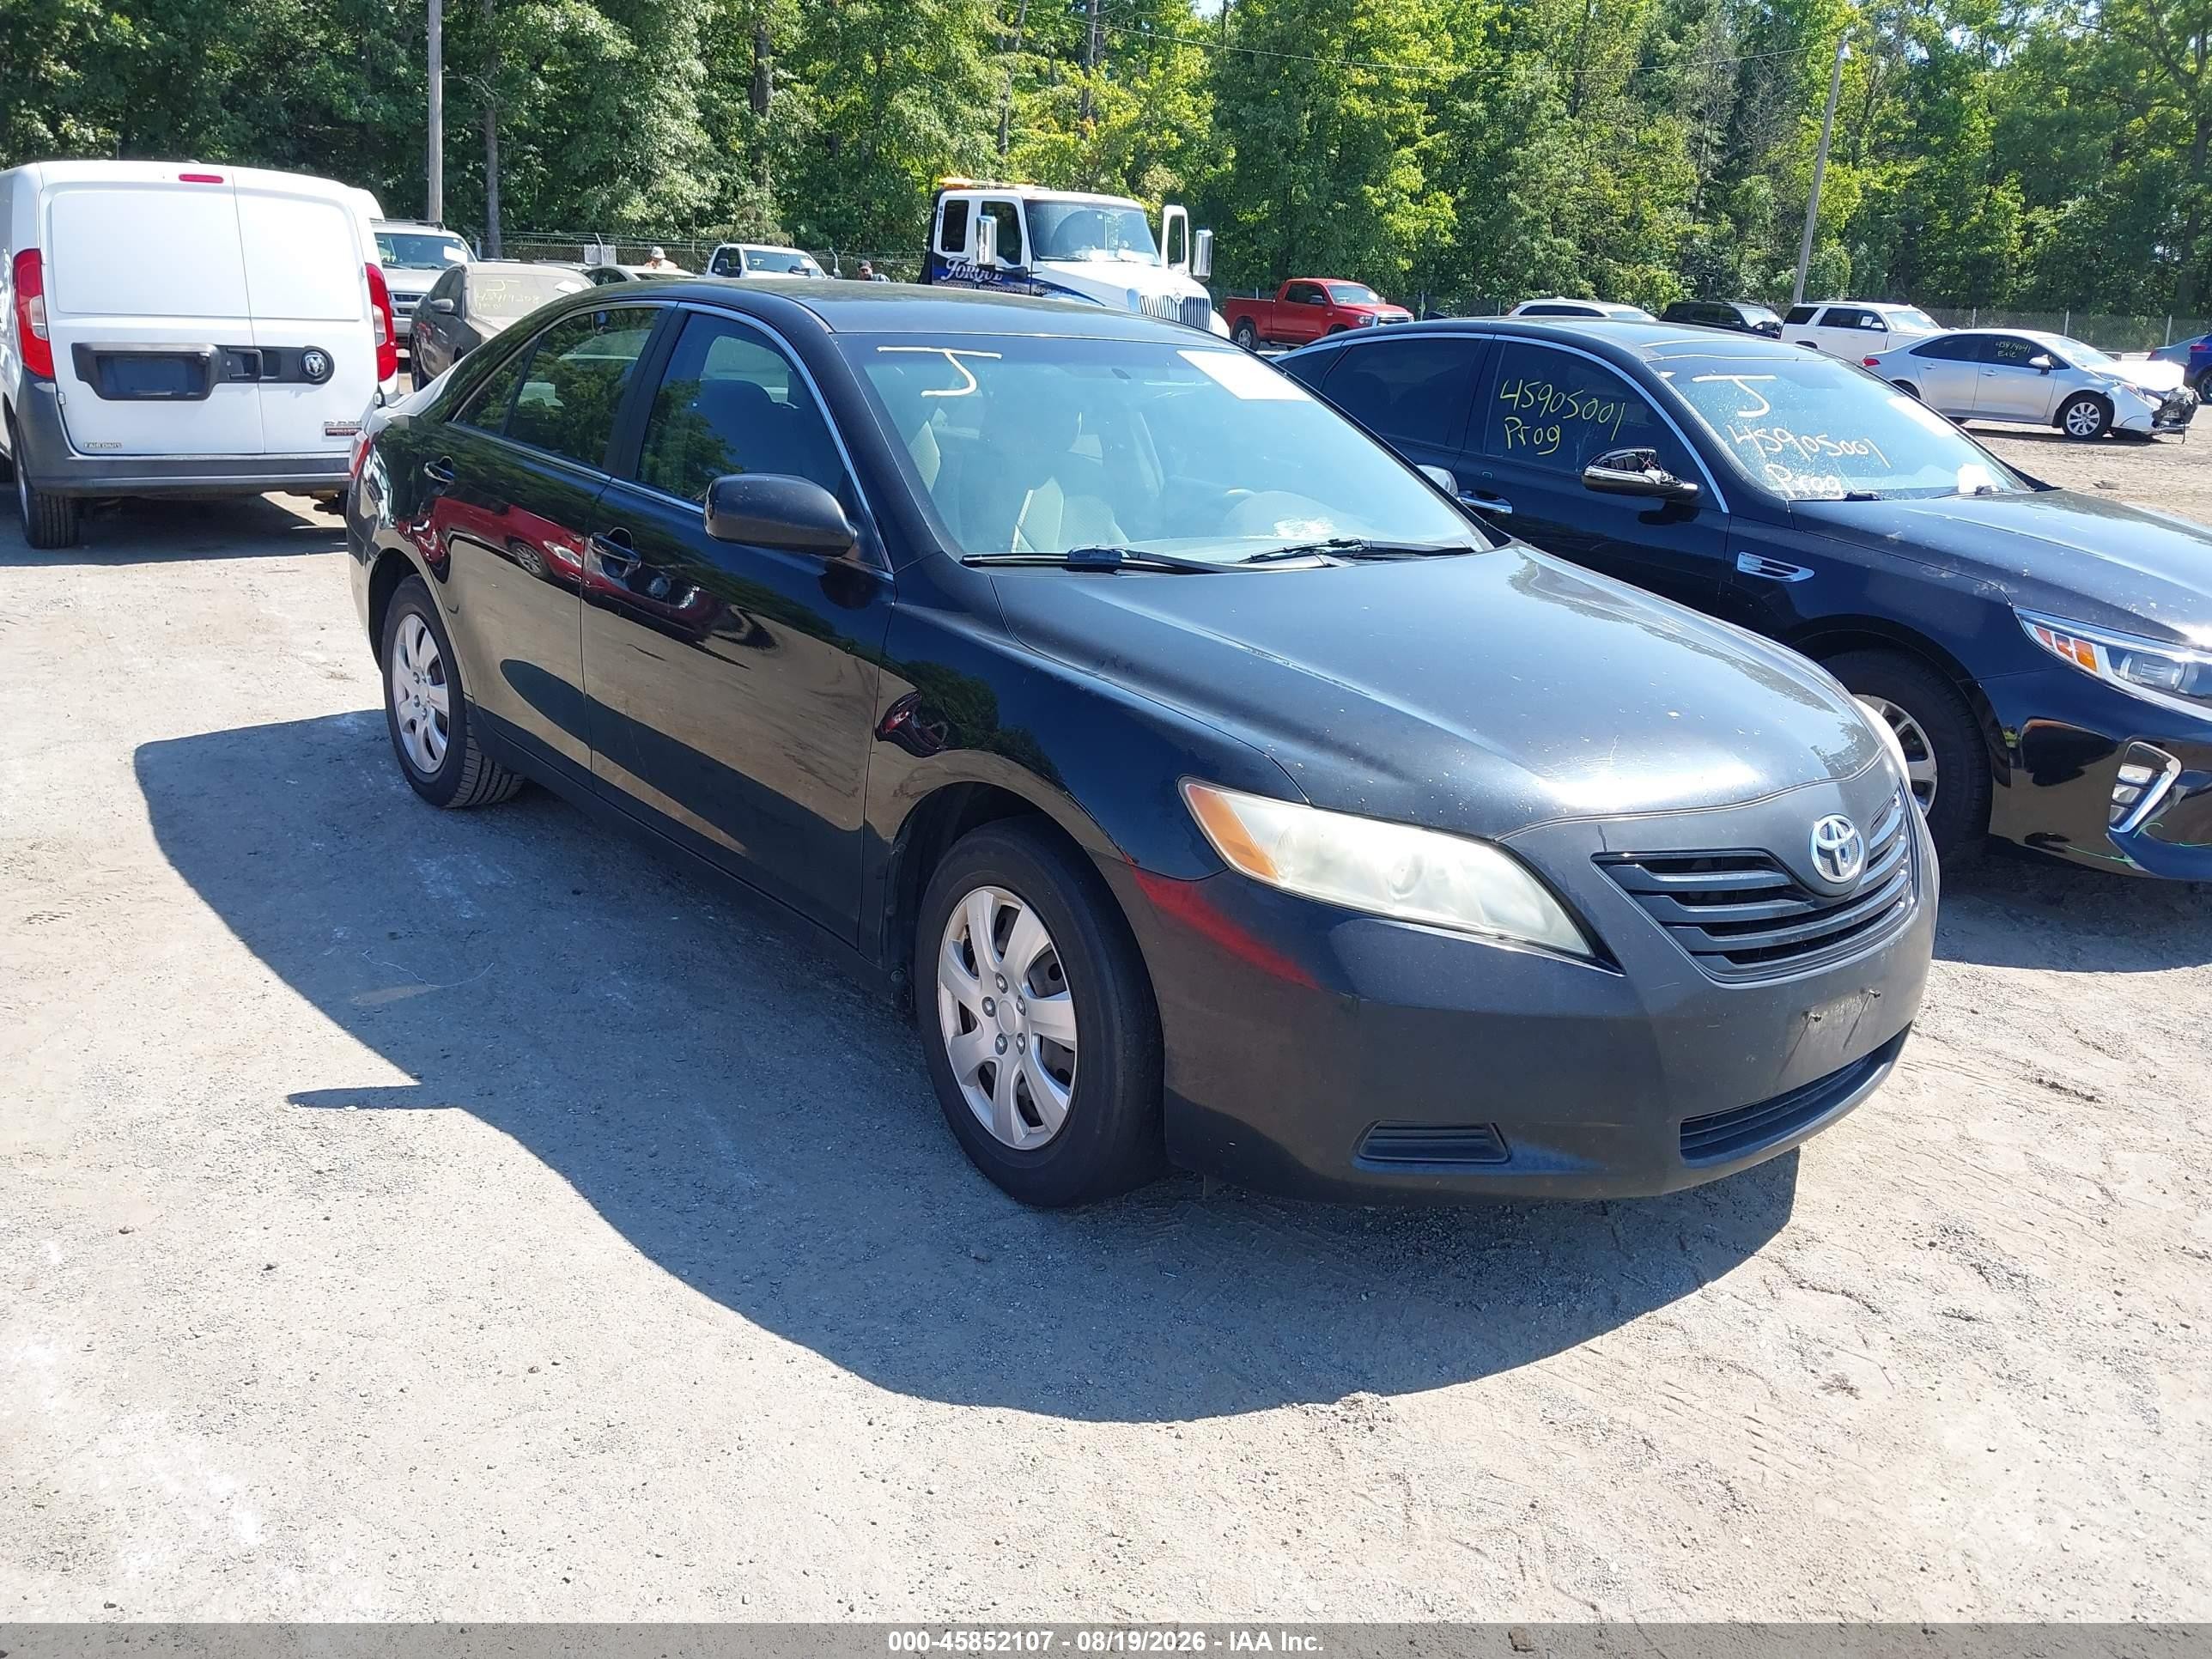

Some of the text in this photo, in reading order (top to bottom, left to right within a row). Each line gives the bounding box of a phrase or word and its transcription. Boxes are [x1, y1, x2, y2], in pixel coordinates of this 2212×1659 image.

[876, 346, 1003, 398] J
[1499, 379, 1626, 442] 45905001
[1692, 374, 1778, 418] J
[1504, 416, 1561, 455] Prog
[1726, 423, 1893, 469] 45905001
